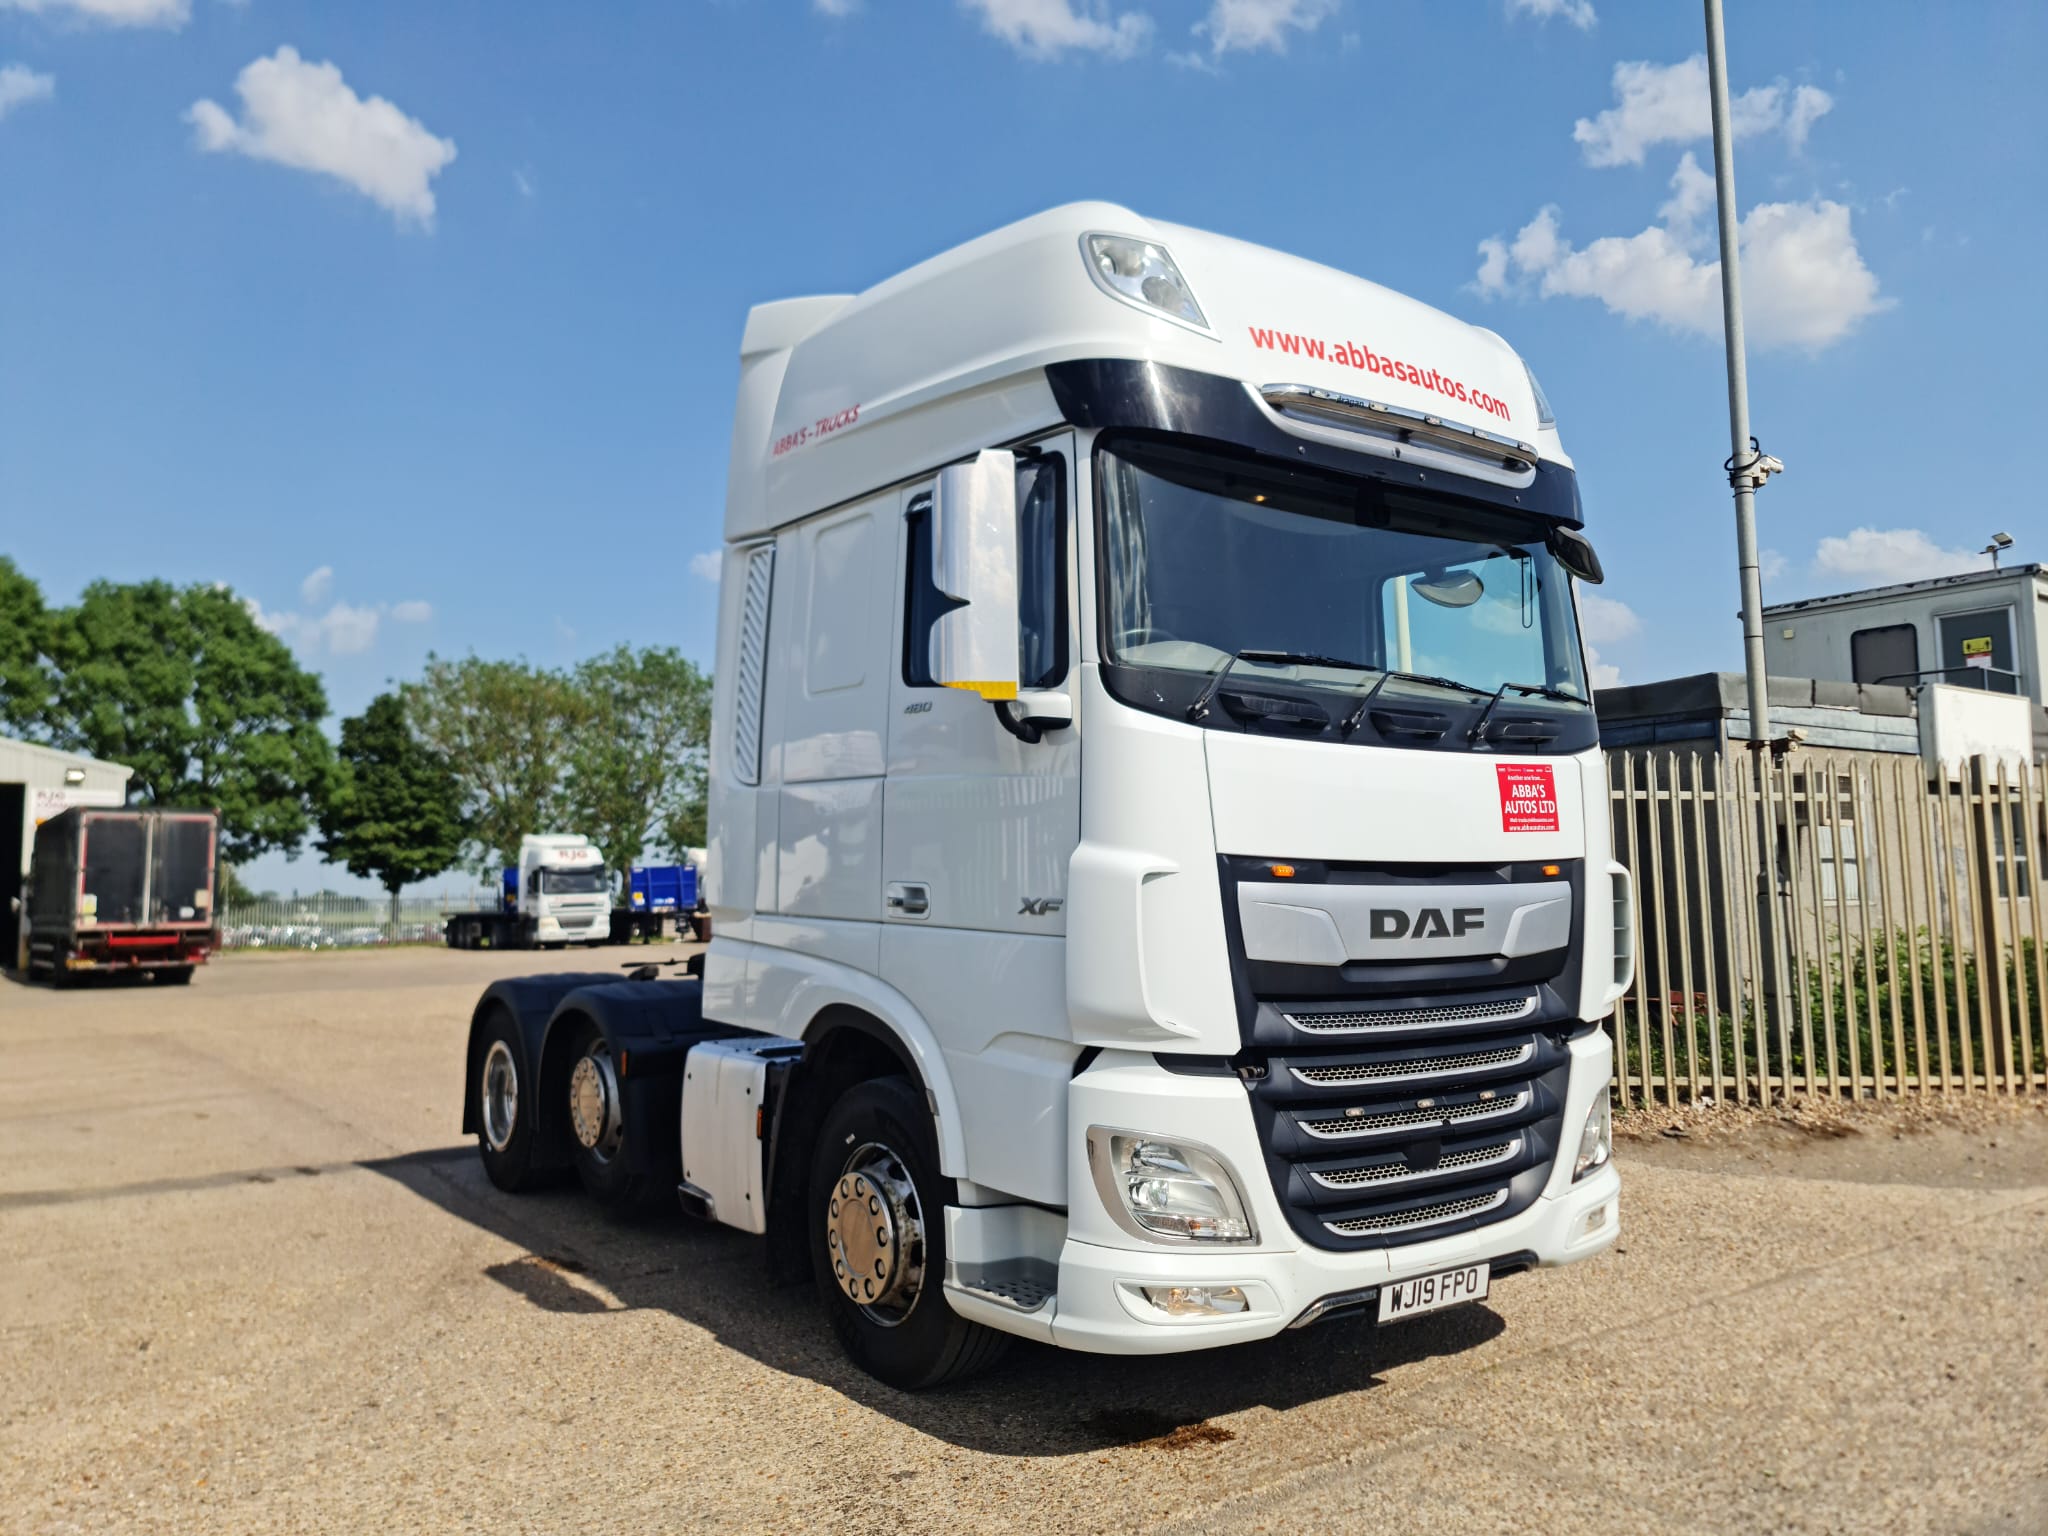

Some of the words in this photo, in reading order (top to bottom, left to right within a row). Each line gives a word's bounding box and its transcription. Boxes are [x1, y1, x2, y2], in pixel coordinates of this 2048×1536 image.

[1248, 326, 1511, 422] www.abbasautos.com
[1512, 784, 1546, 798] ABBA'S
[1505, 800, 1537, 814] AUTOS
[1539, 800, 1555, 814] LTD
[1018, 896, 1064, 916] XF
[1370, 907, 1485, 940] DAF
[1390, 1278, 1434, 1312] WJ19
[1440, 1268, 1477, 1300] FPO
